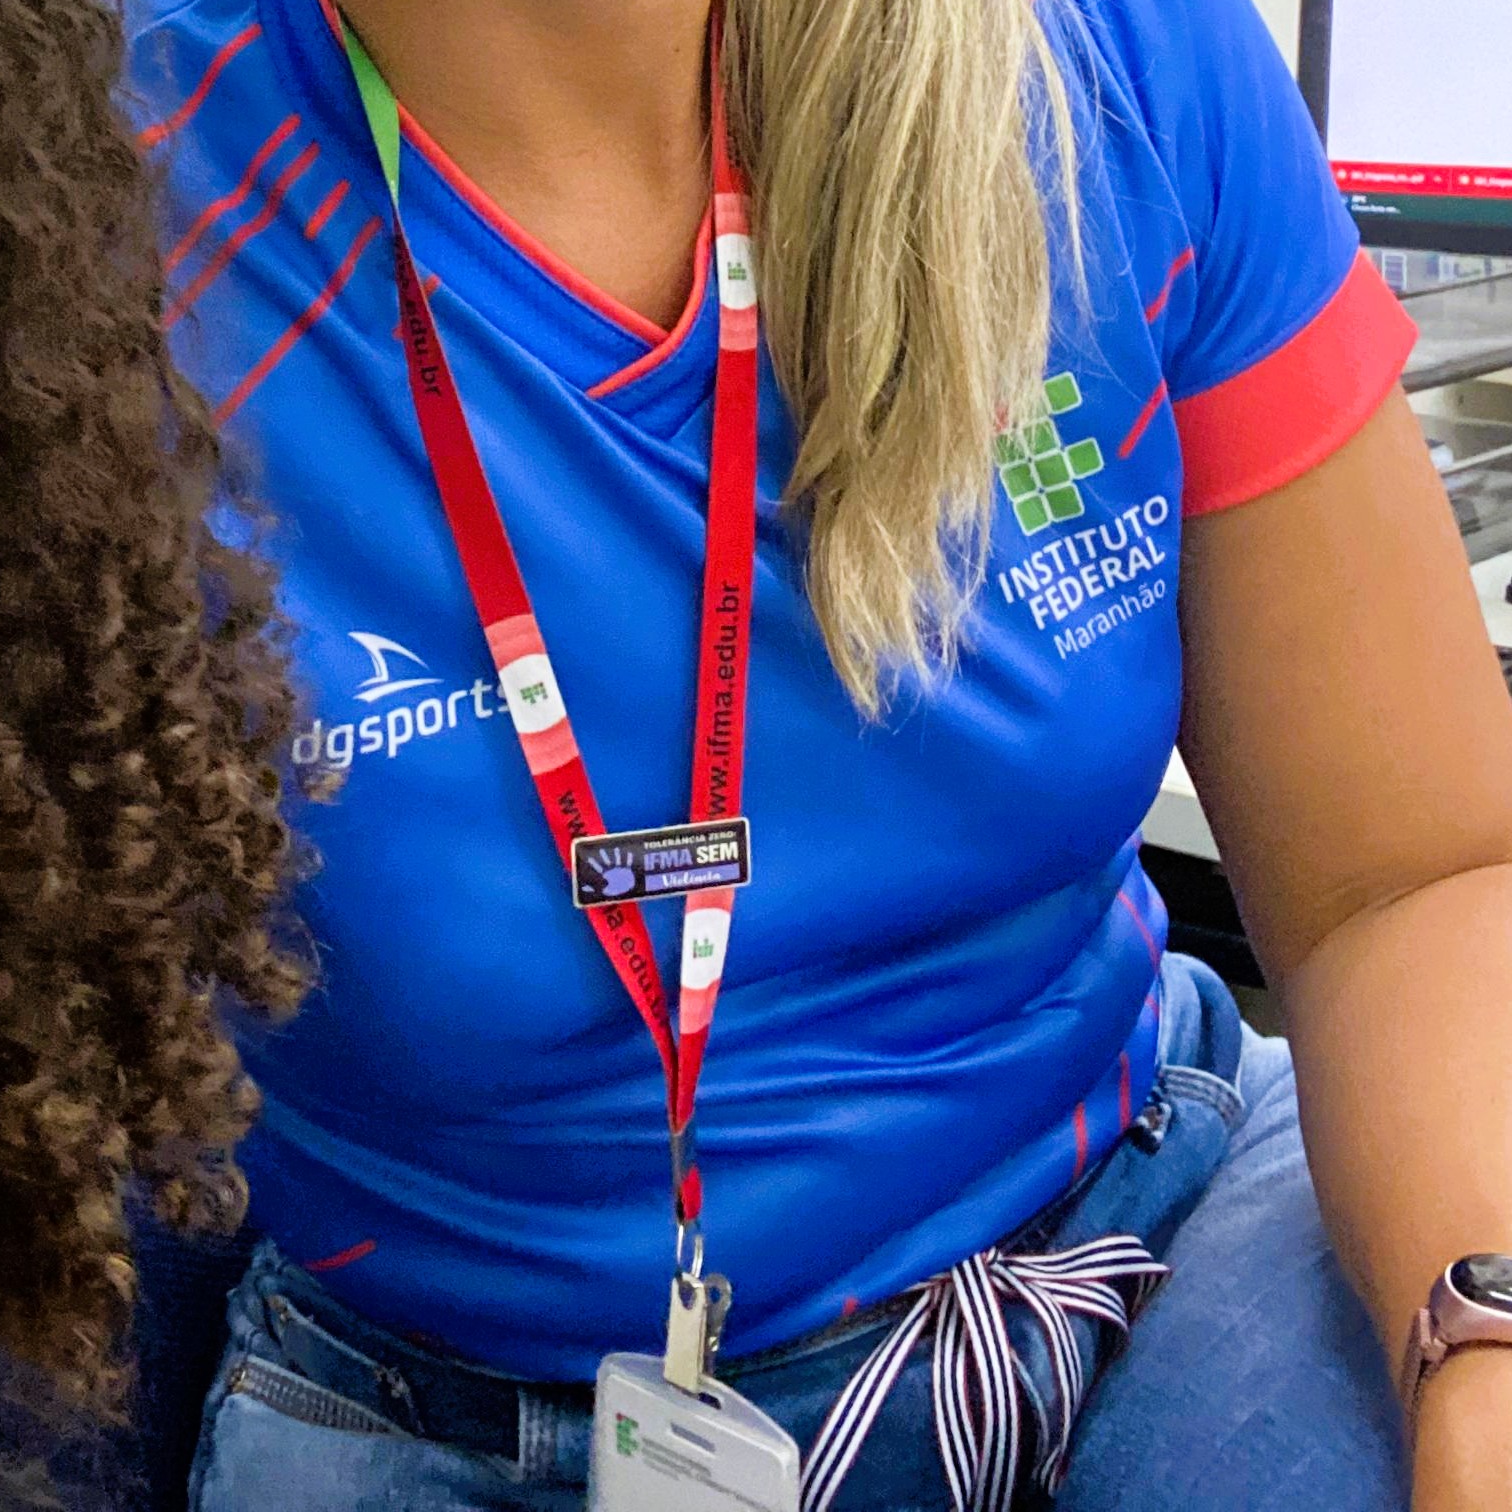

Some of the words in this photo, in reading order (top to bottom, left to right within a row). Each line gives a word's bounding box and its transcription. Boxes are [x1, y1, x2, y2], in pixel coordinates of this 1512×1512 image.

[998, 495, 1169, 604] INSTITUTO
[1028, 536, 1166, 631] FEDERAL
[1053, 578, 1166, 660] Maranhão
[706, 579, 740, 818] ww.ifma.edu.br
[644, 848, 693, 871] IFMA
[696, 841, 739, 865] SEM
